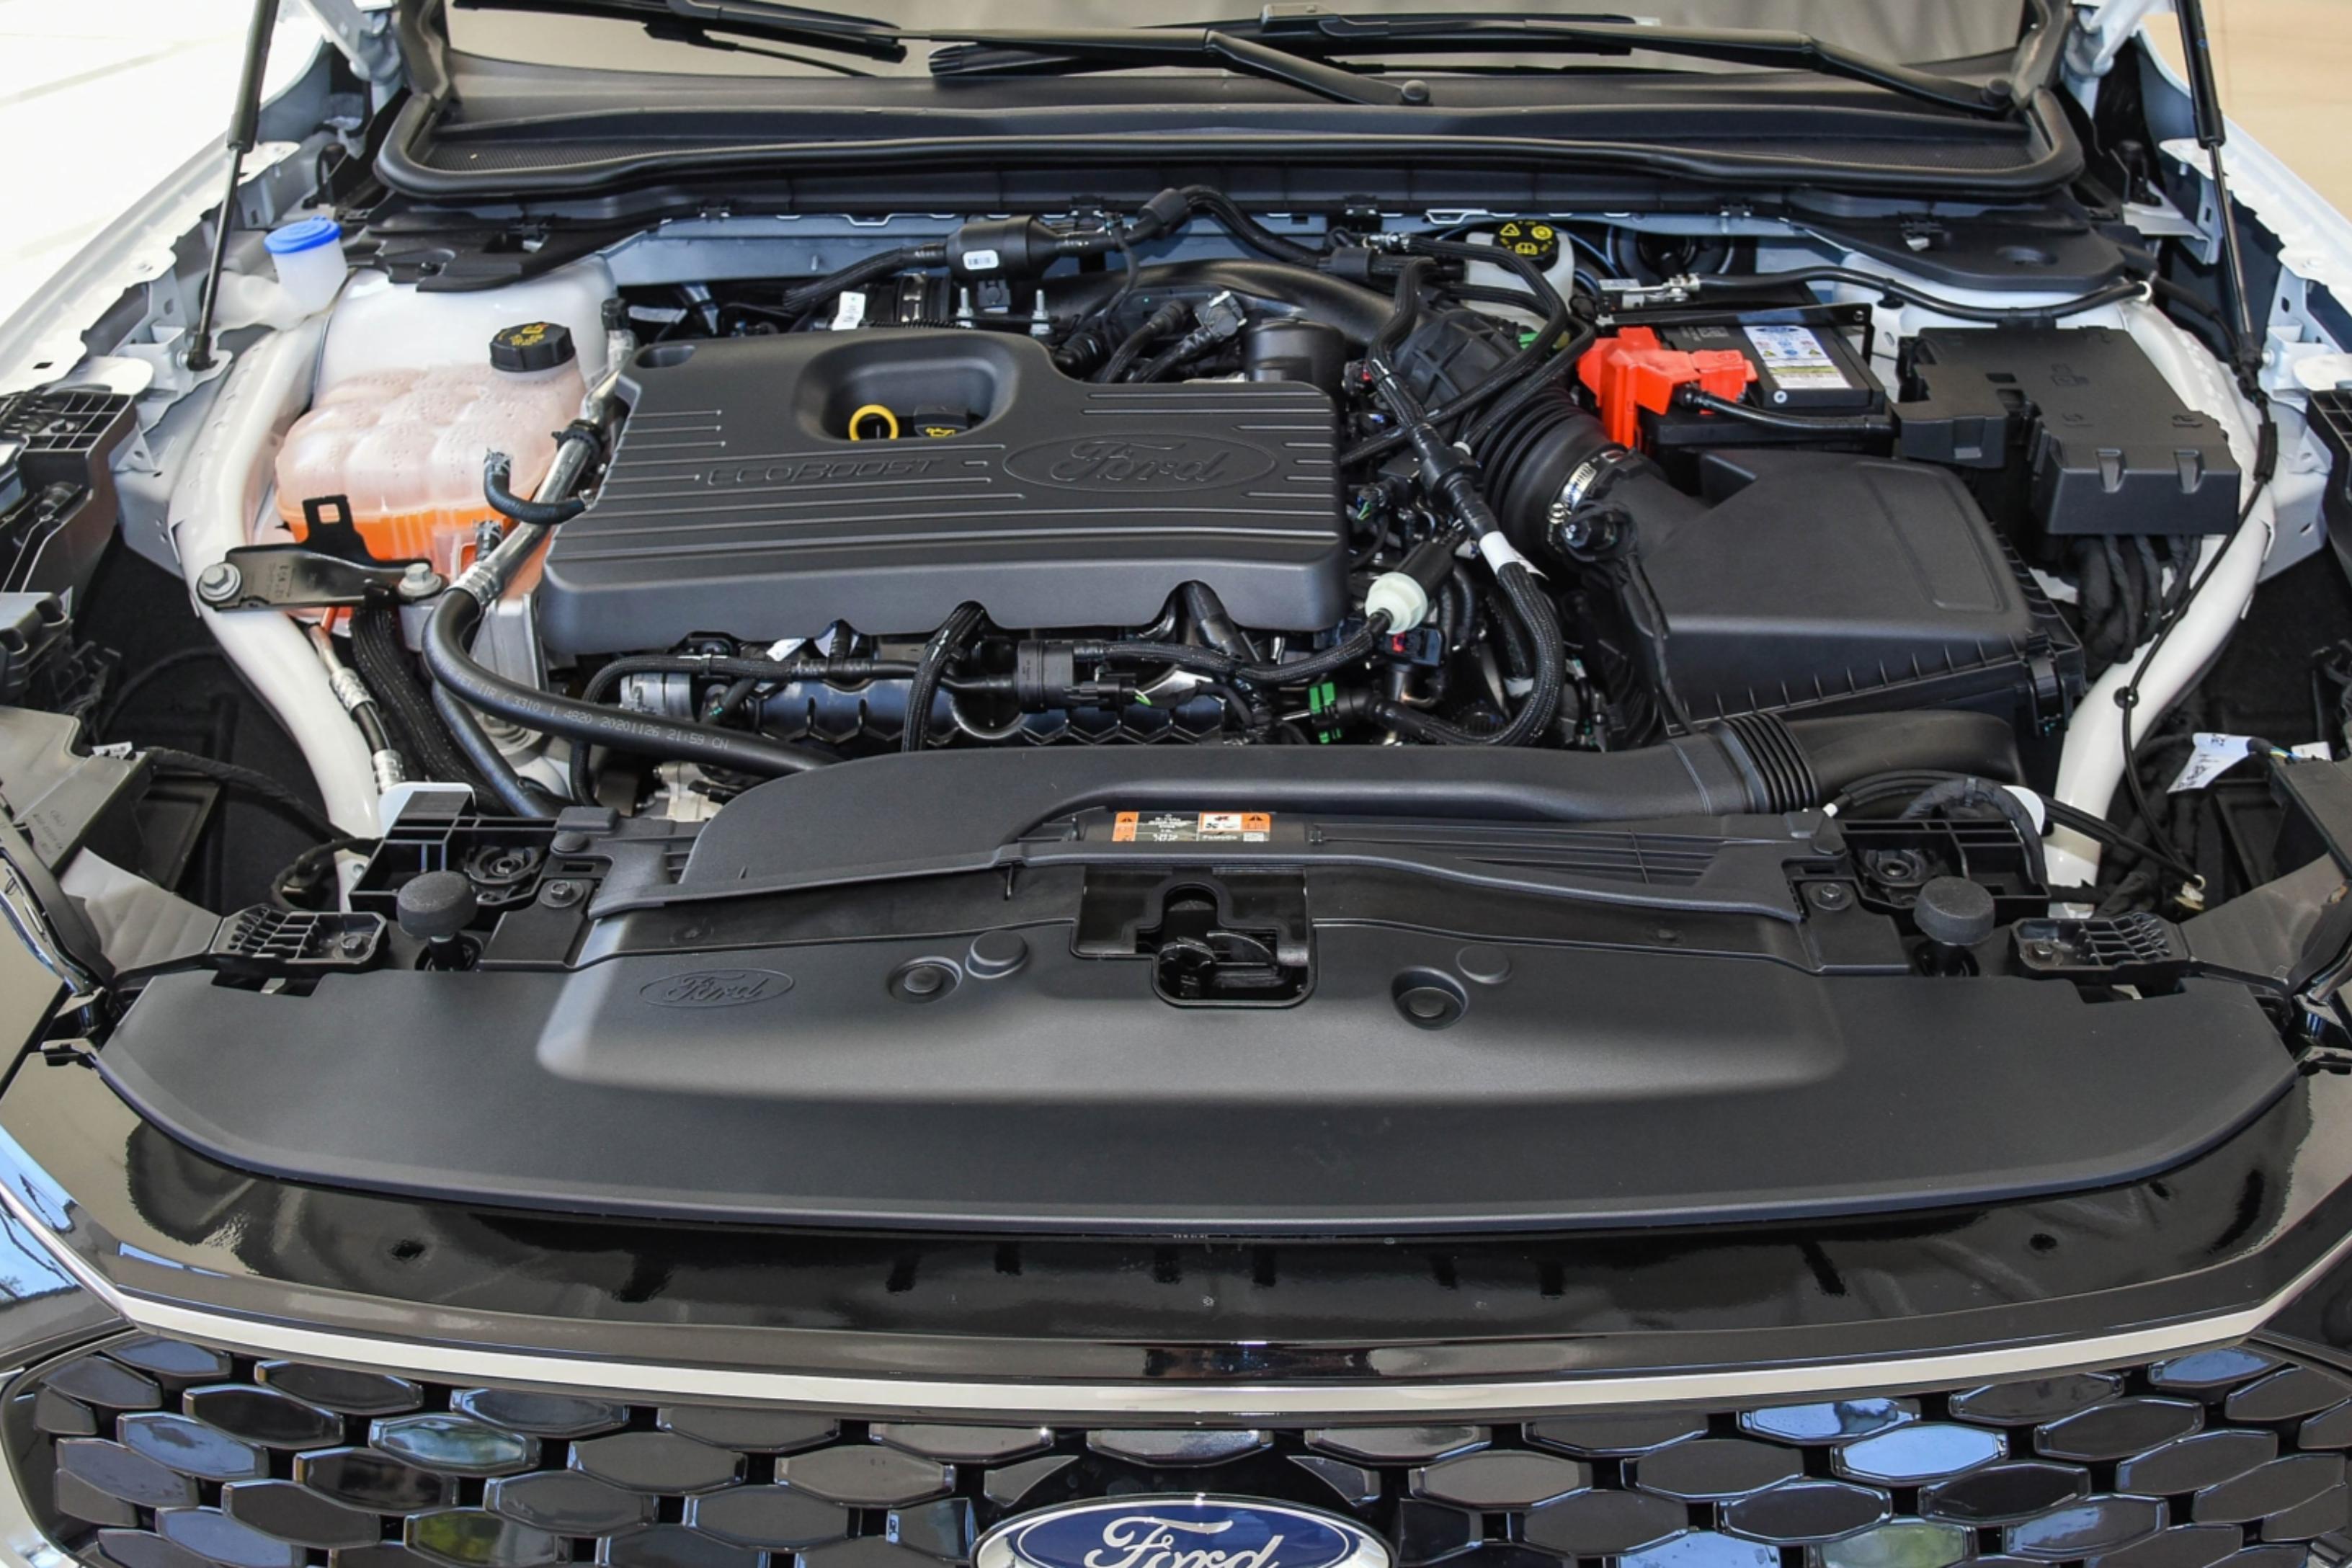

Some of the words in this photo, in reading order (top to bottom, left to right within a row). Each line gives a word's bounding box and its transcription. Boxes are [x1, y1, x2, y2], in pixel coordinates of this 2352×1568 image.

[1049, 440, 1231, 482] Ford
[512, 695, 541, 713] 3310
[599, 716, 660, 737] 20201126
[667, 729, 705, 745] 21:59
[711, 737, 730, 750] CN
[663, 974, 770, 1002] Ford
[1084, 1515, 1285, 1568] Ford
